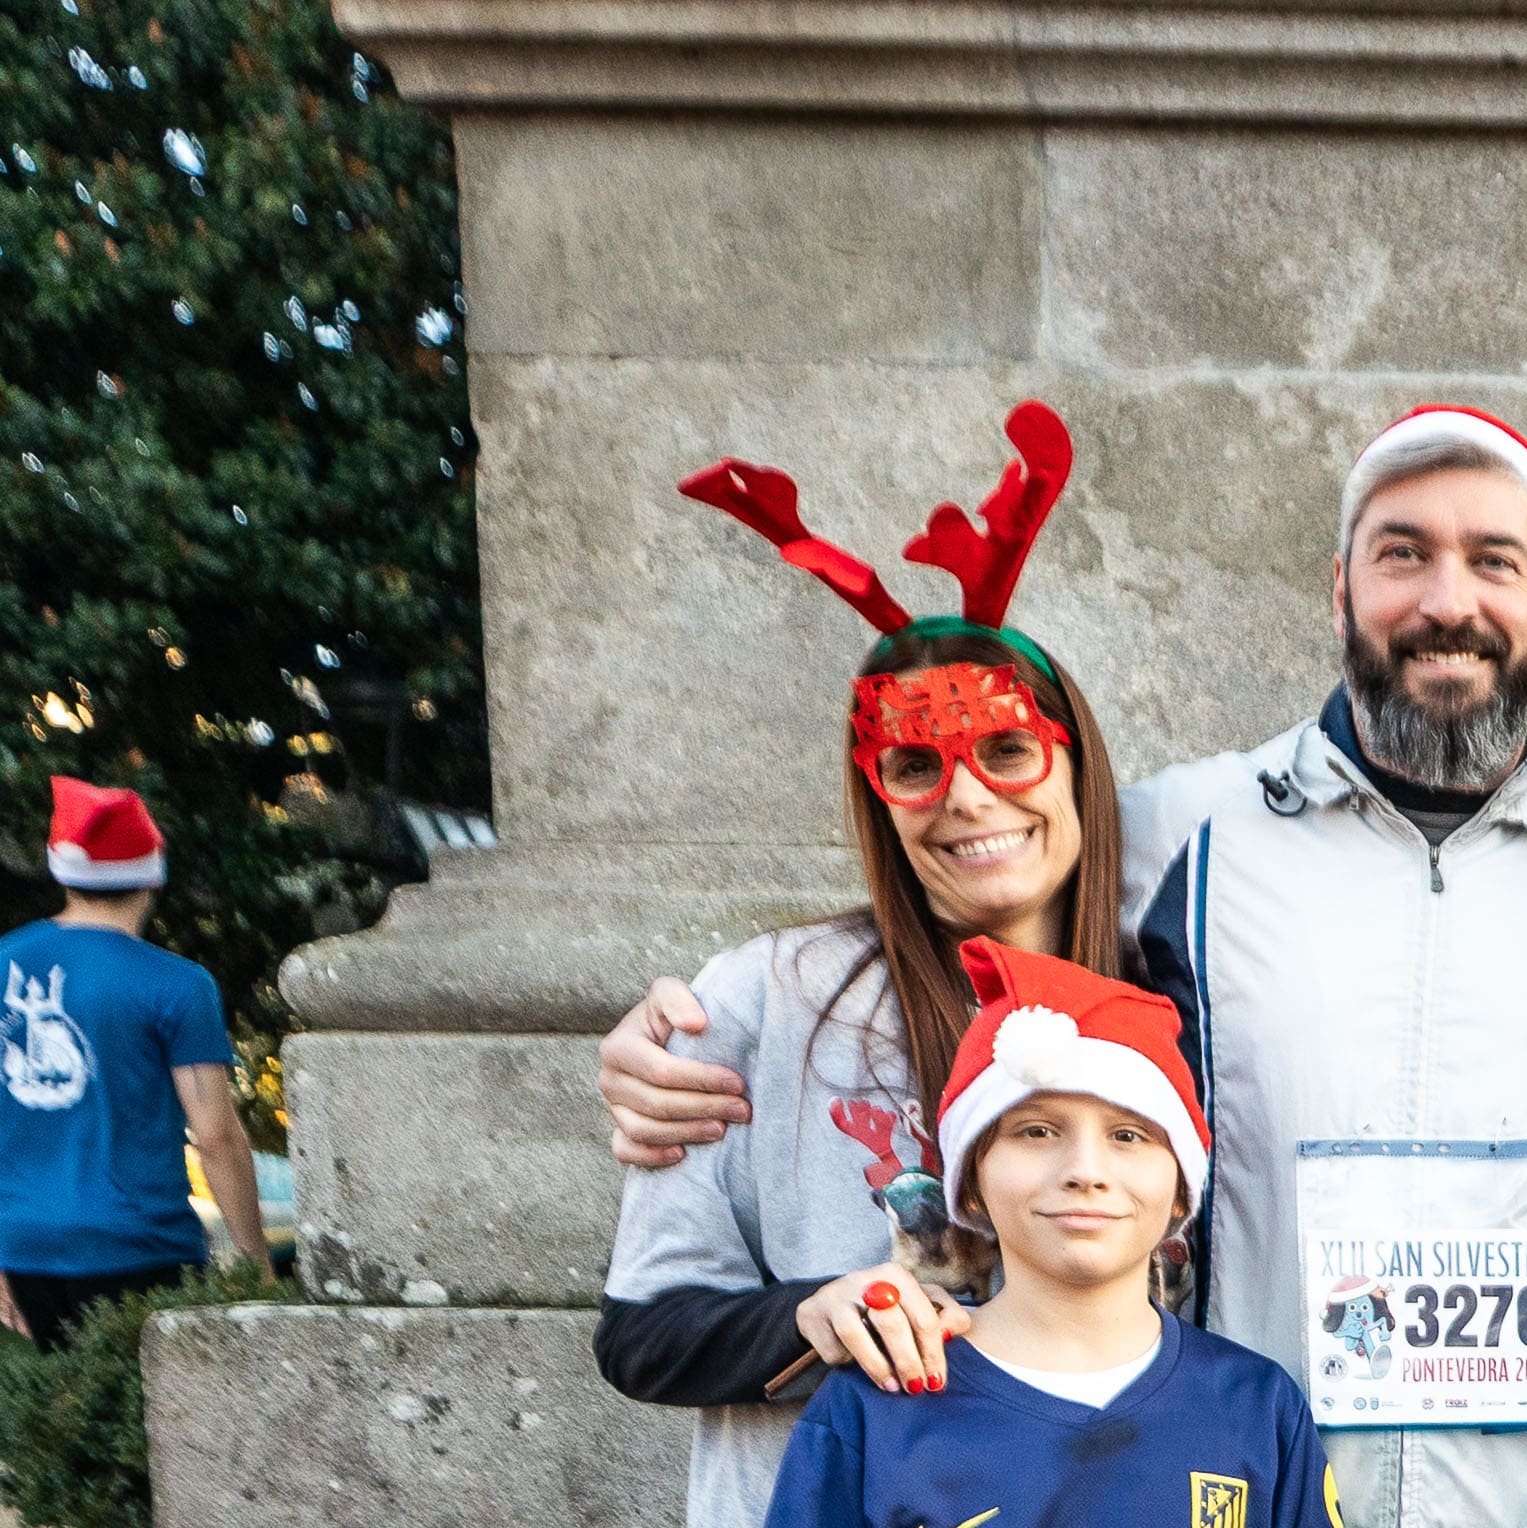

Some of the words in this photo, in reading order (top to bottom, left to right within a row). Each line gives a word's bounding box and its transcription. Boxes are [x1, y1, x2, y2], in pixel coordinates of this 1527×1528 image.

[1320, 1240, 1365, 1277] XLII
[1375, 1241, 1423, 1277] SAN
[1402, 1357, 1509, 1382] PONTEVEDRA
